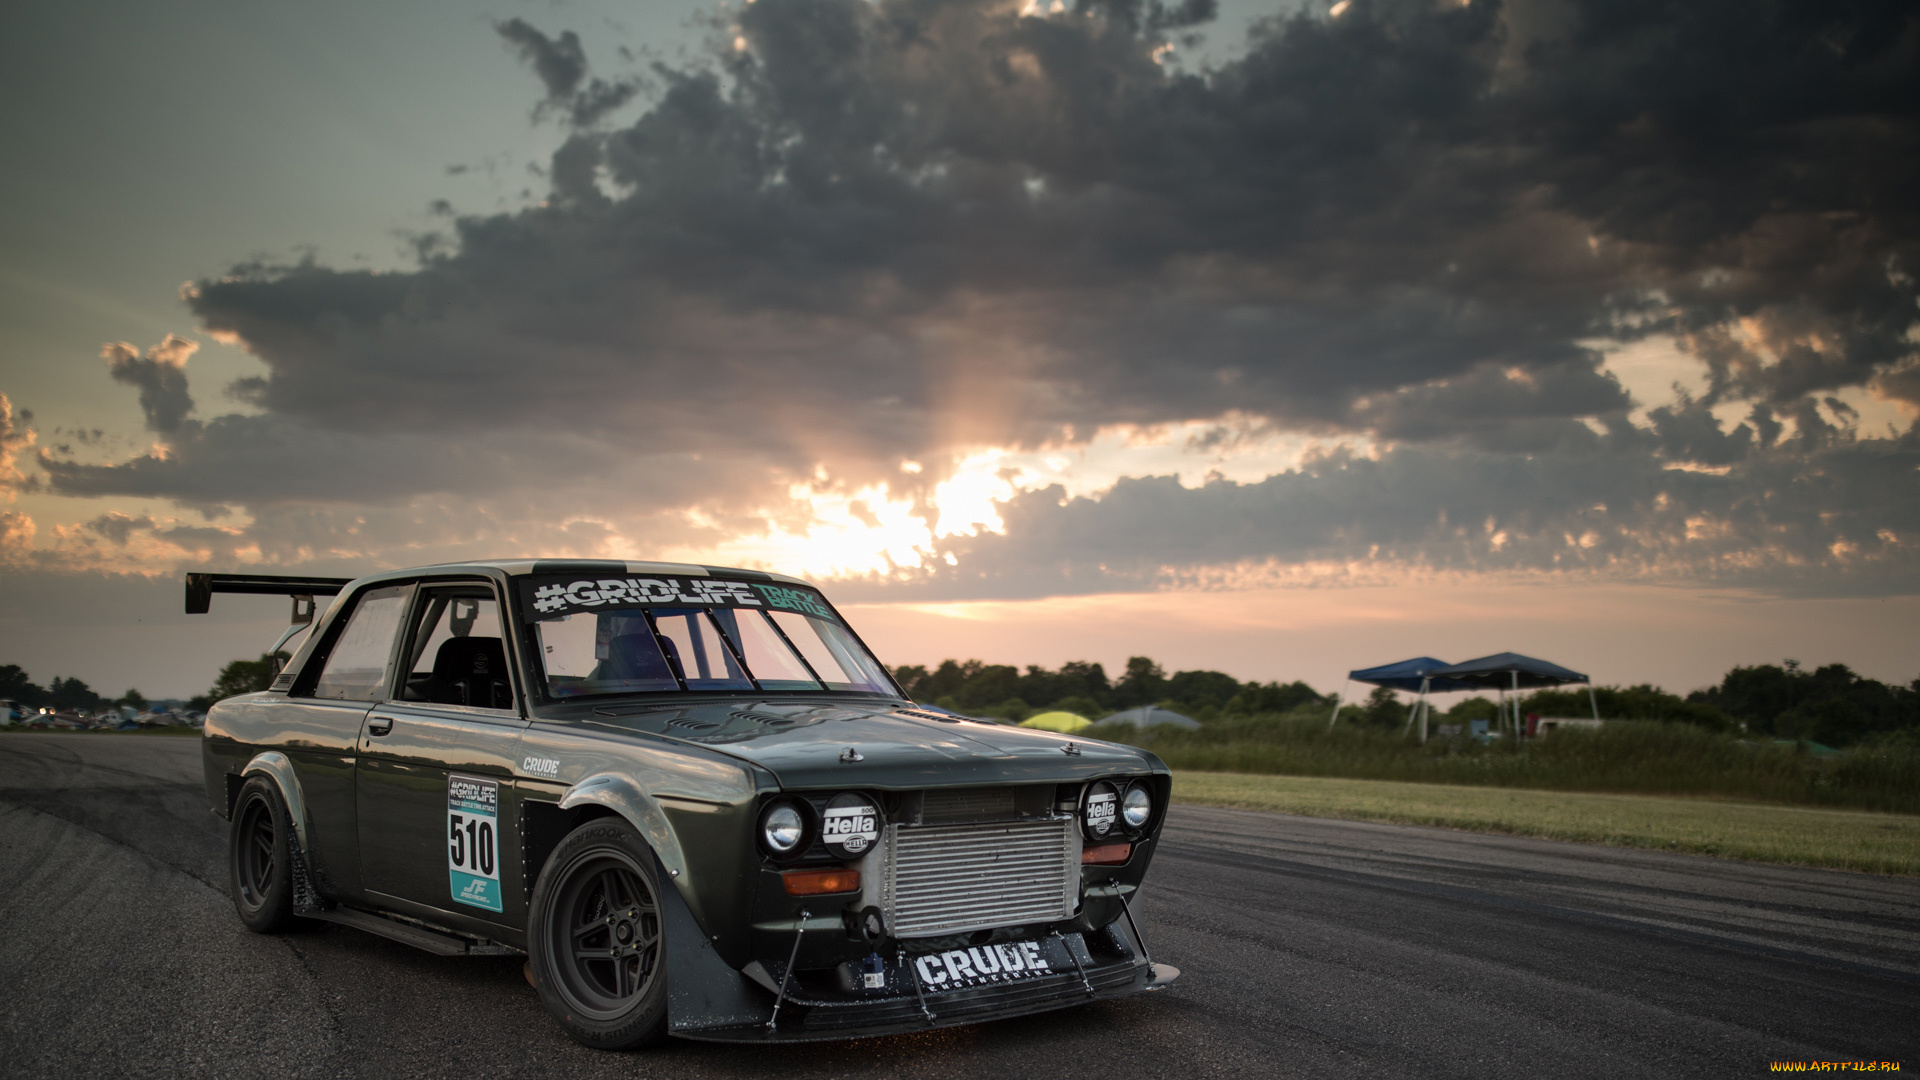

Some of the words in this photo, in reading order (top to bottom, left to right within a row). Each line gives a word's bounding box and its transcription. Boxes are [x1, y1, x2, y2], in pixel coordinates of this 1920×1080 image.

[533, 579, 762, 613] #GRIDLIFE
[751, 584, 815, 604] TRACK
[768, 596, 834, 620] BATTLE
[523, 757, 560, 774] CRUDE
[450, 781, 496, 804] #GRIDLIFE
[1087, 802, 1115, 818] Hella
[823, 815, 875, 834] Hella
[450, 813, 494, 876] 510
[916, 941, 1049, 985] CRUDE
[929, 969, 1053, 993] ENGINEERING
